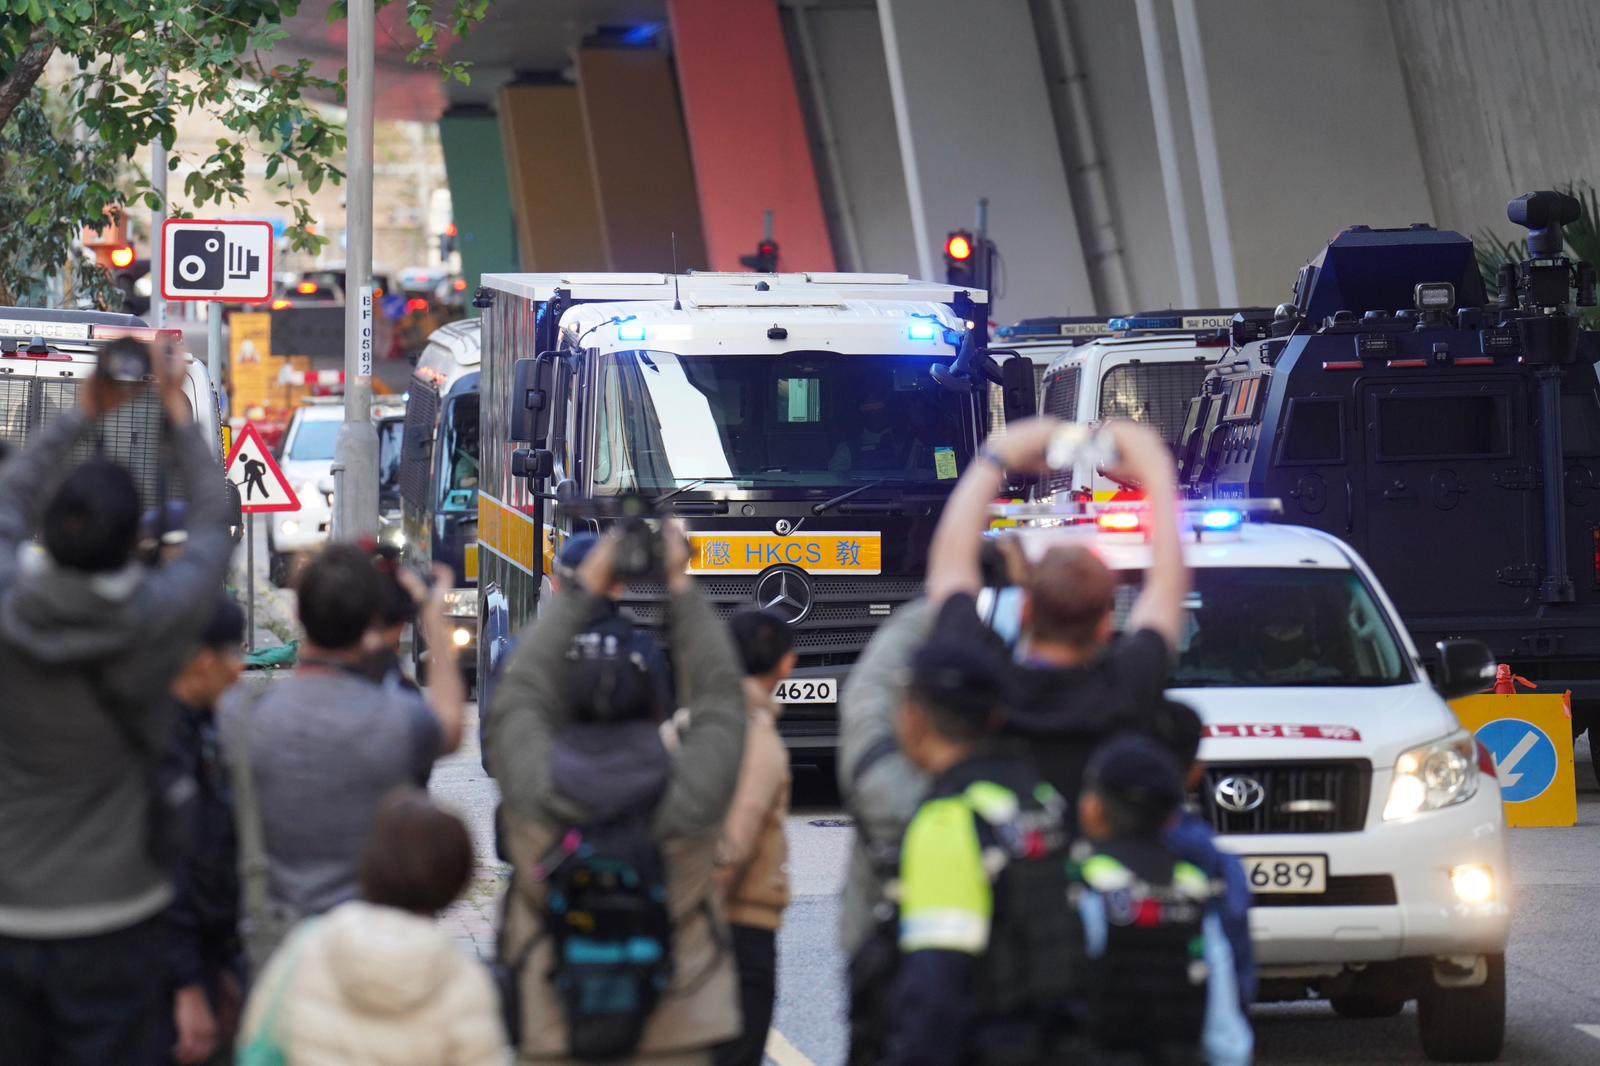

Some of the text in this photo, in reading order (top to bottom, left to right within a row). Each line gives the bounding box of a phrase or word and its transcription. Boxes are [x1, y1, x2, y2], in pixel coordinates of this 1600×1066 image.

[14, 323, 64, 336] POLICE
[1078, 325, 1107, 334] POLIC
[1202, 318, 1233, 328] POLIC
[362, 327, 371, 374] 0582
[746, 543, 822, 563] HKCS
[775, 682, 830, 700] 4620
[1209, 724, 1306, 738] LICE
